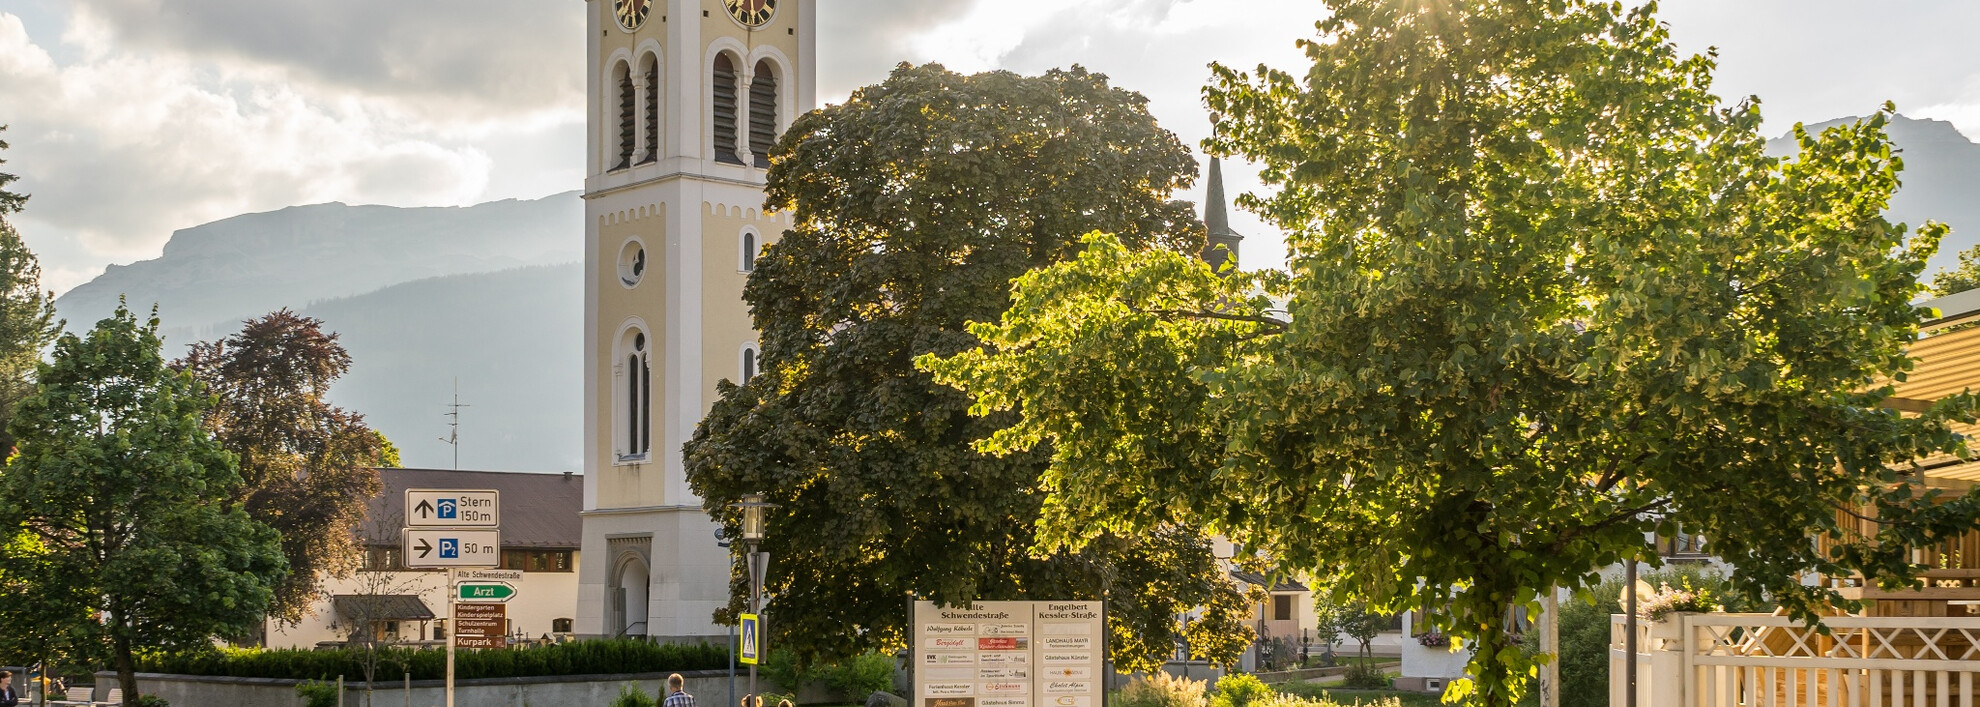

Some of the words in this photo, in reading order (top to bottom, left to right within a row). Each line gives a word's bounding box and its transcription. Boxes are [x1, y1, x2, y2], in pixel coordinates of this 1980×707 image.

[460, 496, 491, 507] Stern
[464, 543, 478, 554] 50
[483, 545, 494, 554] m
[472, 571, 520, 579] Schwendestraße
[473, 587, 494, 596] Arzt
[1048, 604, 1088, 612] Engelbert
[457, 638, 492, 647] Kurpark
